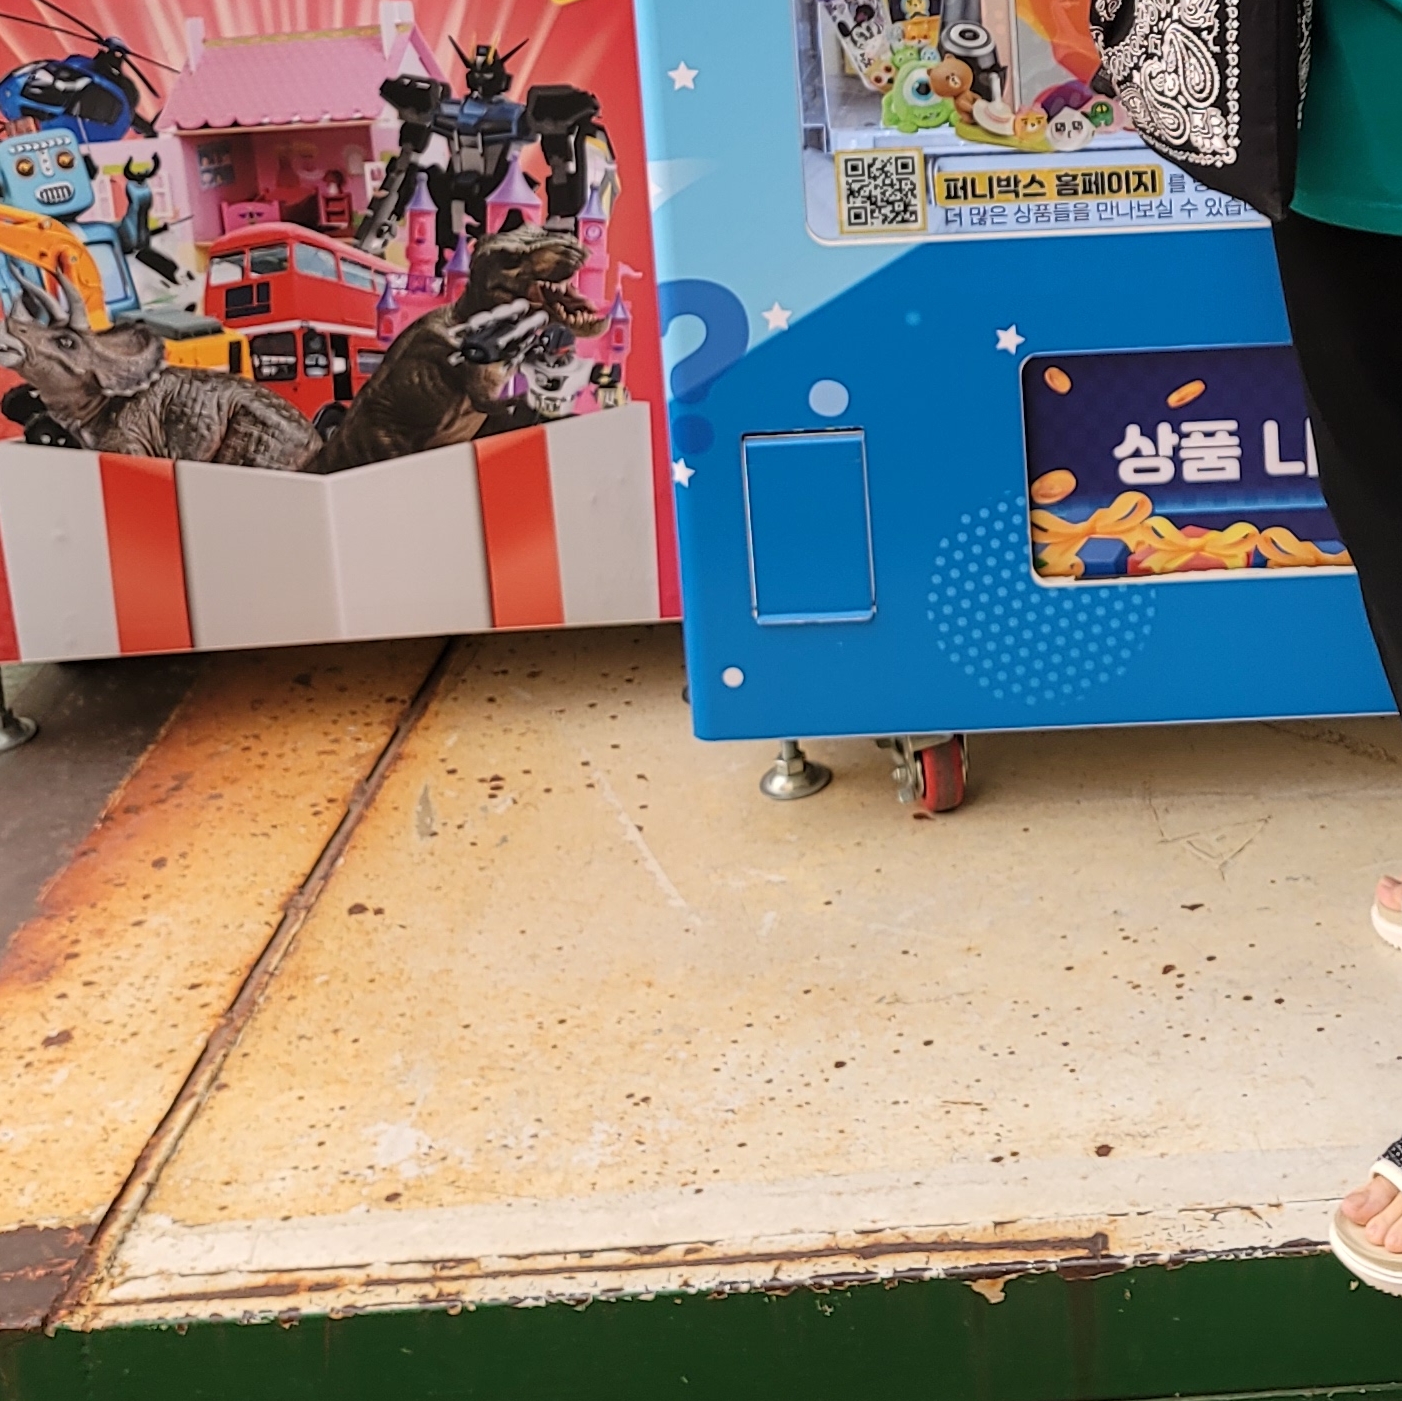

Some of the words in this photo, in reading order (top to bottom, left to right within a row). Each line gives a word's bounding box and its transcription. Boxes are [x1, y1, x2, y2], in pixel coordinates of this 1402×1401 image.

[943, 173, 1047, 202] 퍼니박스
[1055, 168, 1158, 197] 홈페이지
[945, 208, 963, 227] 더
[969, 206, 1008, 226] 많은
[1013, 202, 1089, 225] 상품들을
[1096, 200, 1173, 220] 만나보실
[1180, 198, 1198, 218] 수
[1112, 419, 1242, 485] 상품
